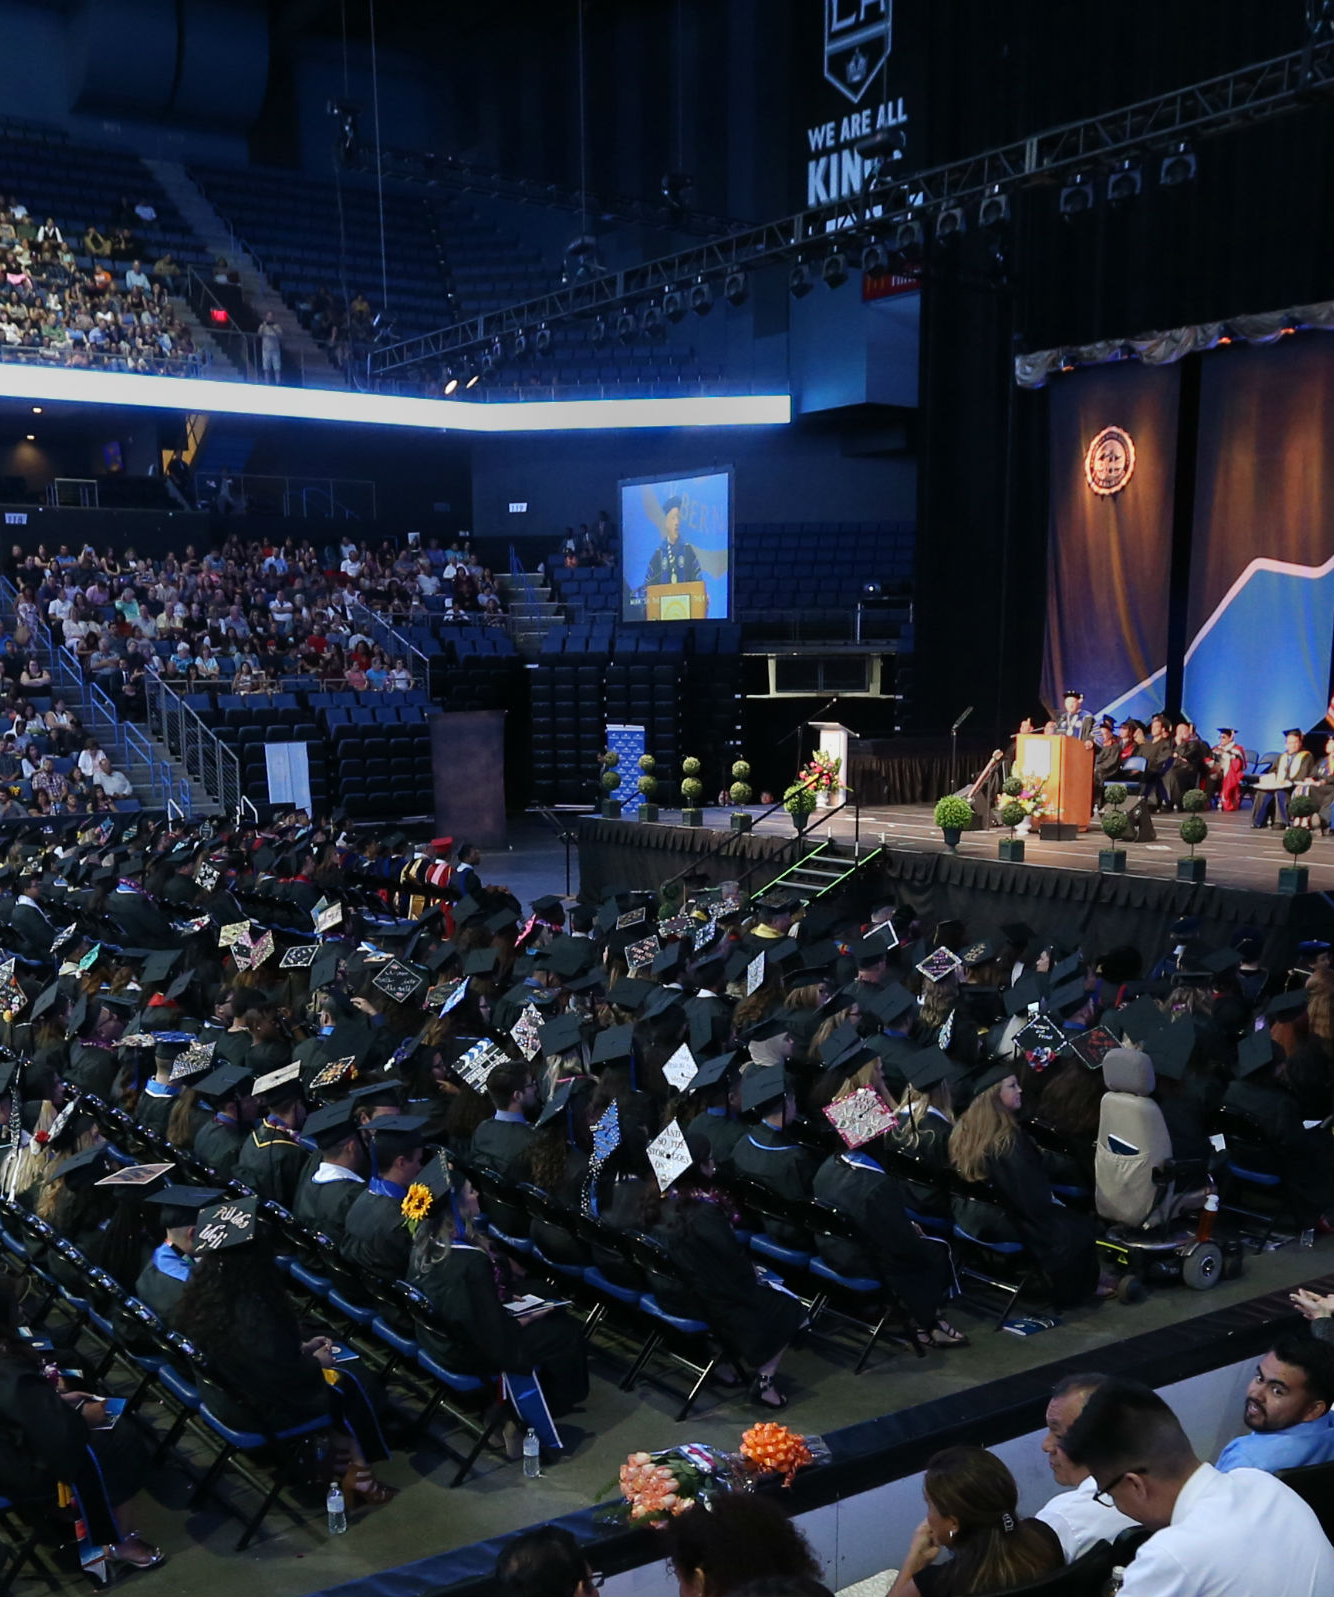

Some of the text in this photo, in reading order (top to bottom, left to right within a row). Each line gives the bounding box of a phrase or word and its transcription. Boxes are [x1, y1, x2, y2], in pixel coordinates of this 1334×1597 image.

[808, 97, 908, 151] WE ARE ALL
[664, 1127, 681, 1138] AND
[657, 1136, 666, 1146] SO
